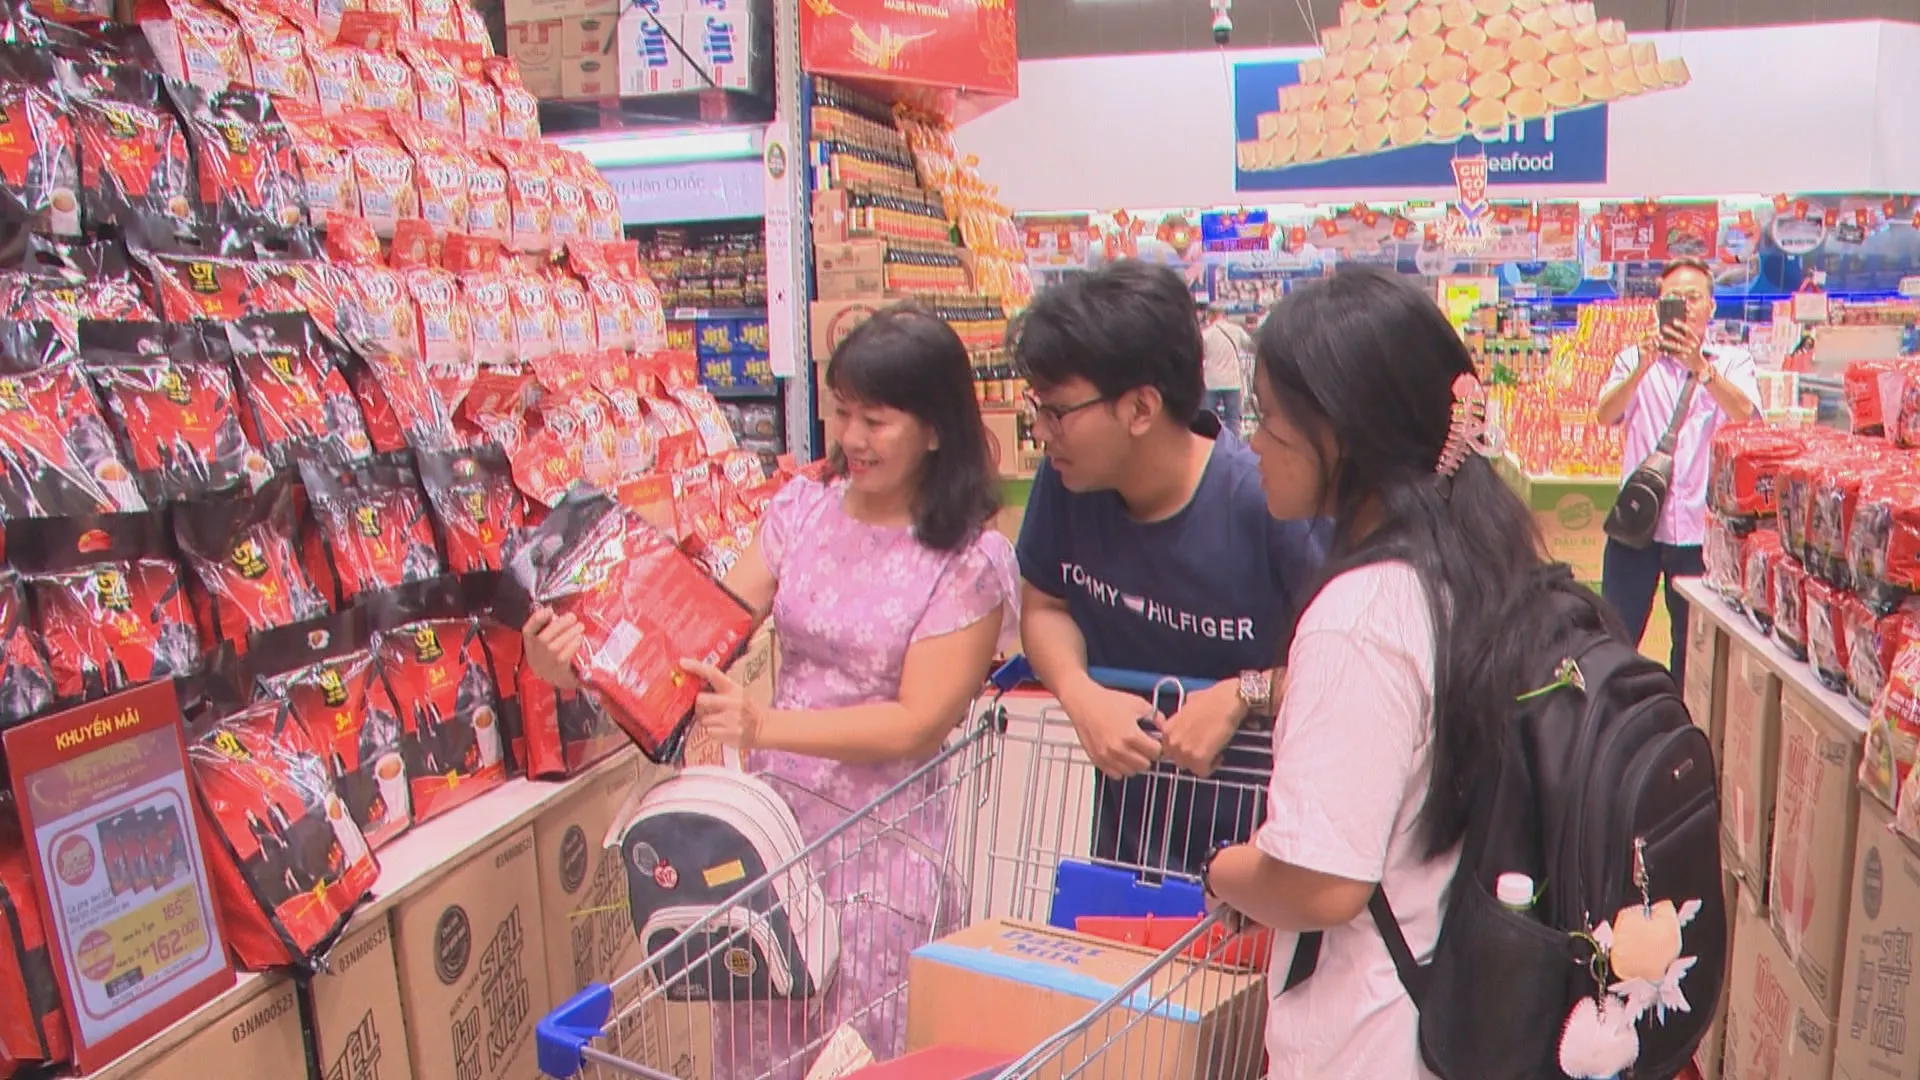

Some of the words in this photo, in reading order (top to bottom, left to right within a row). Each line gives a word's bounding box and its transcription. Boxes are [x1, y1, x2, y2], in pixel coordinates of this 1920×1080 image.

[1488, 152, 1554, 172] eafood
[1060, 562, 1119, 608] TOMMY
[1147, 598, 1255, 641] HILFIGER
[55, 713, 113, 751] KHUYẾN
[114, 707, 141, 733] MÃI
